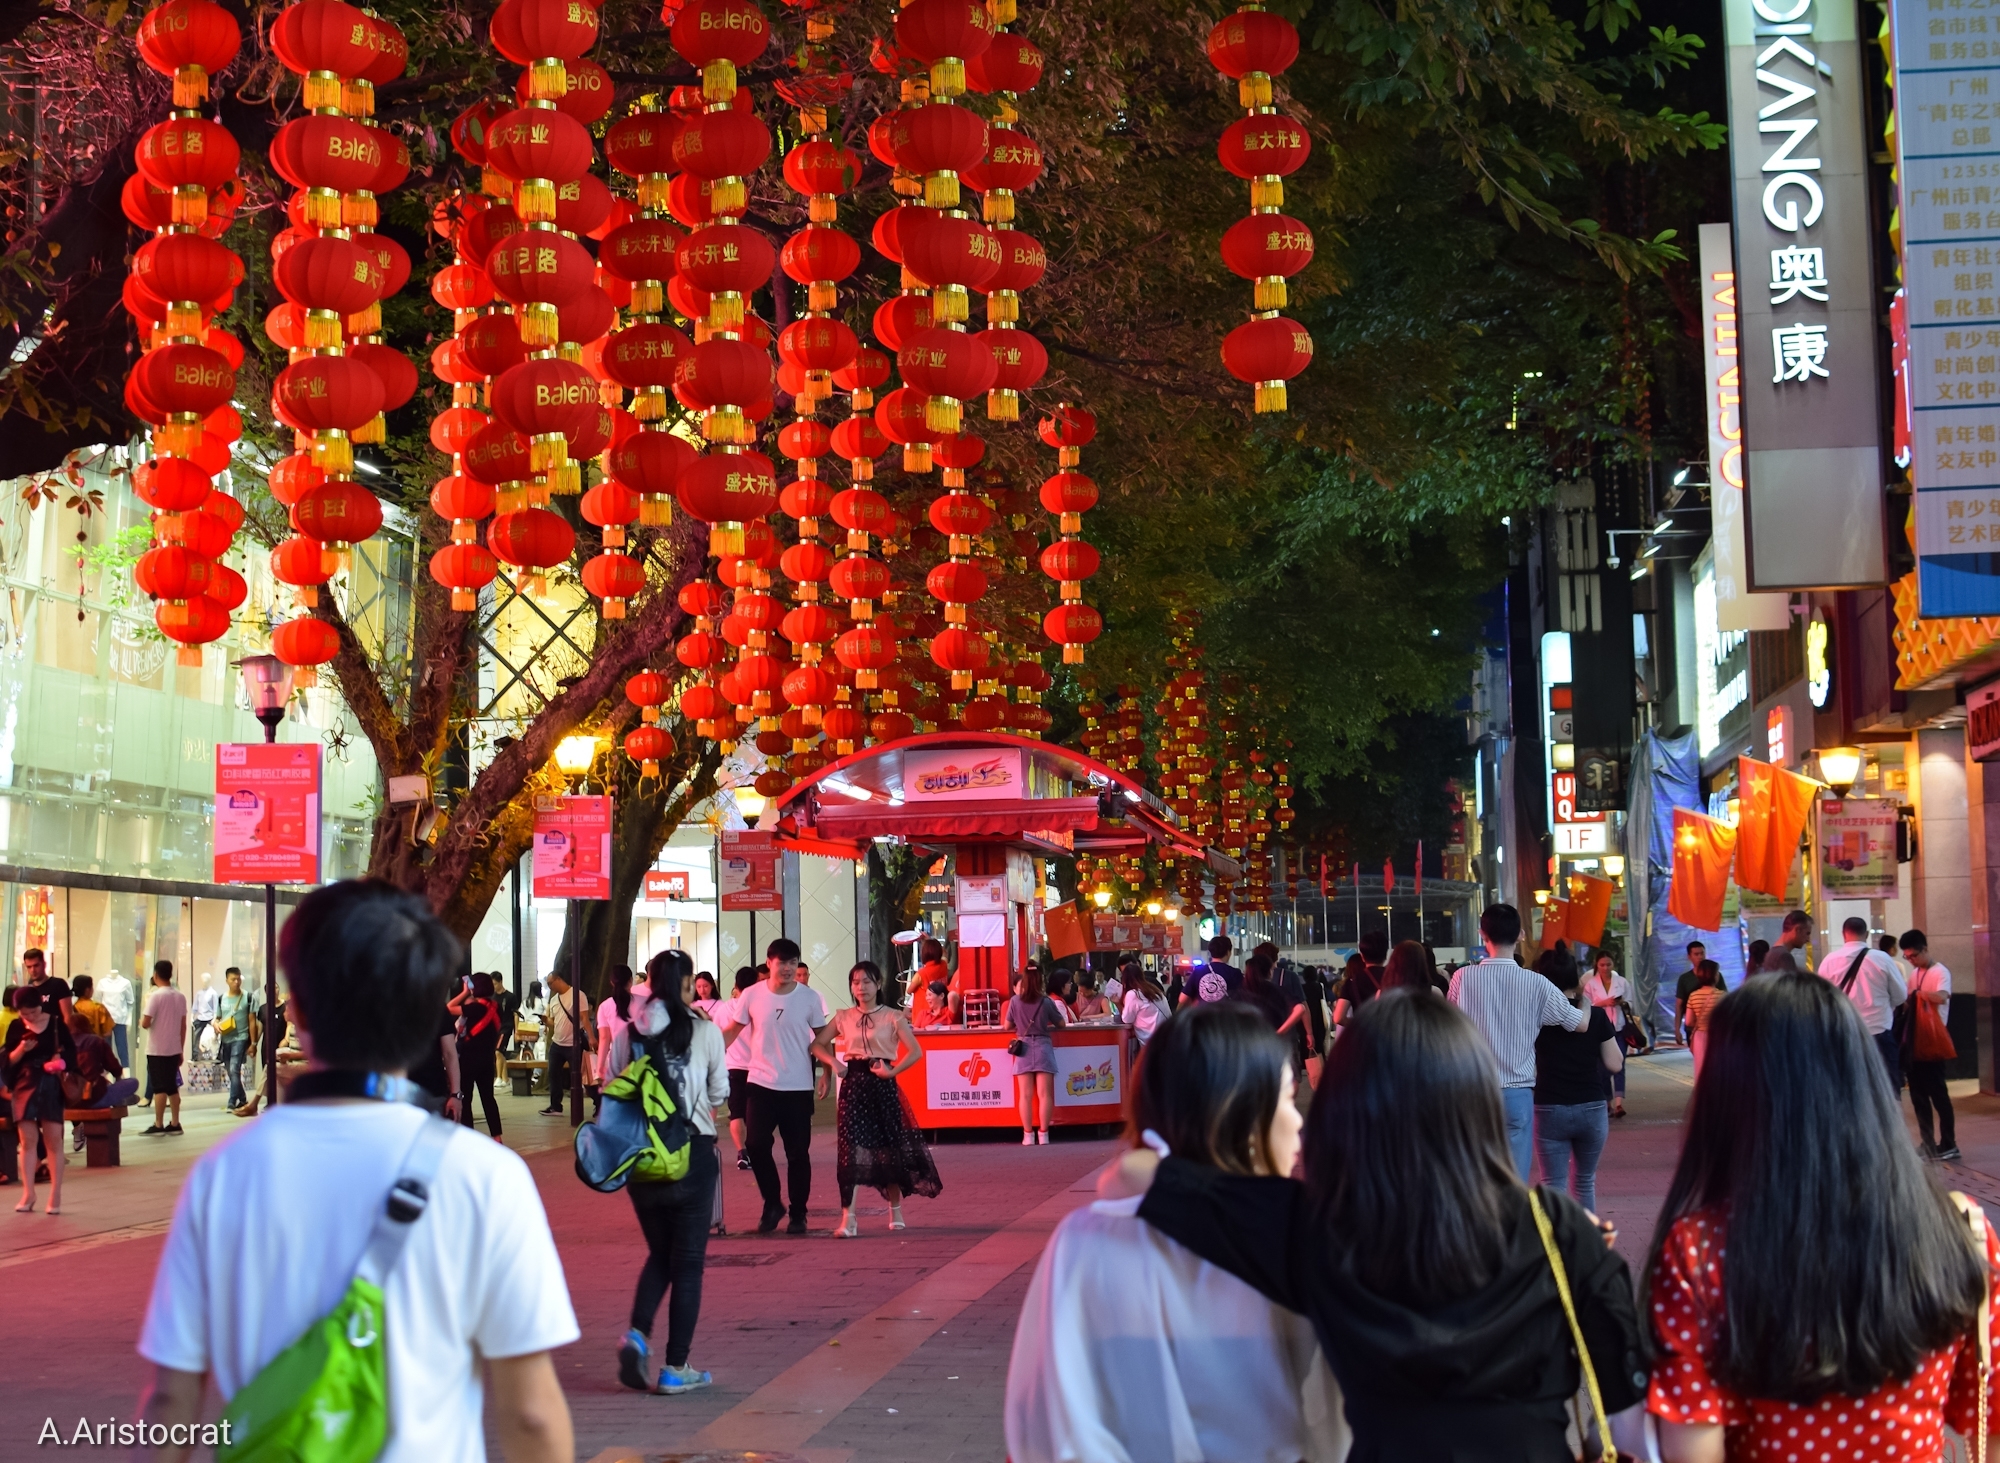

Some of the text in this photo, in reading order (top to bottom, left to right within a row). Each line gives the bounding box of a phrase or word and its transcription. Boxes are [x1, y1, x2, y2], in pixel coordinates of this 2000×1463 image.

[699, 8, 763, 35] Baleno
[1949, 77, 1988, 96] 广州
[1243, 130, 1302, 151] 盛大开业
[1952, 126, 1991, 146] 总部
[327, 136, 381, 168] Baleno
[993, 145, 1041, 168] 盛大开业
[616, 234, 677, 257] 盛大开业
[1266, 230, 1314, 252] 盛大开业
[493, 246, 558, 275] 班尼路
[680, 242, 741, 270] 盛大开业
[1954, 272, 1994, 291] 组织
[1769, 244, 1830, 384] 奥康
[616, 340, 677, 362] 盛大开业
[174, 362, 234, 391] Baleno
[536, 380, 597, 407] Baleno
[724, 472, 776, 498] 盛大开业
[941, 505, 979, 519] 盛大开业
[844, 568, 884, 583] Baleno
[1067, 615, 1101, 629] 盛大开业
[648, 881, 685, 892] Baleno
[775, 1008, 785, 1021] 7
[940, 1090, 1002, 1101] 中国福利彩票
